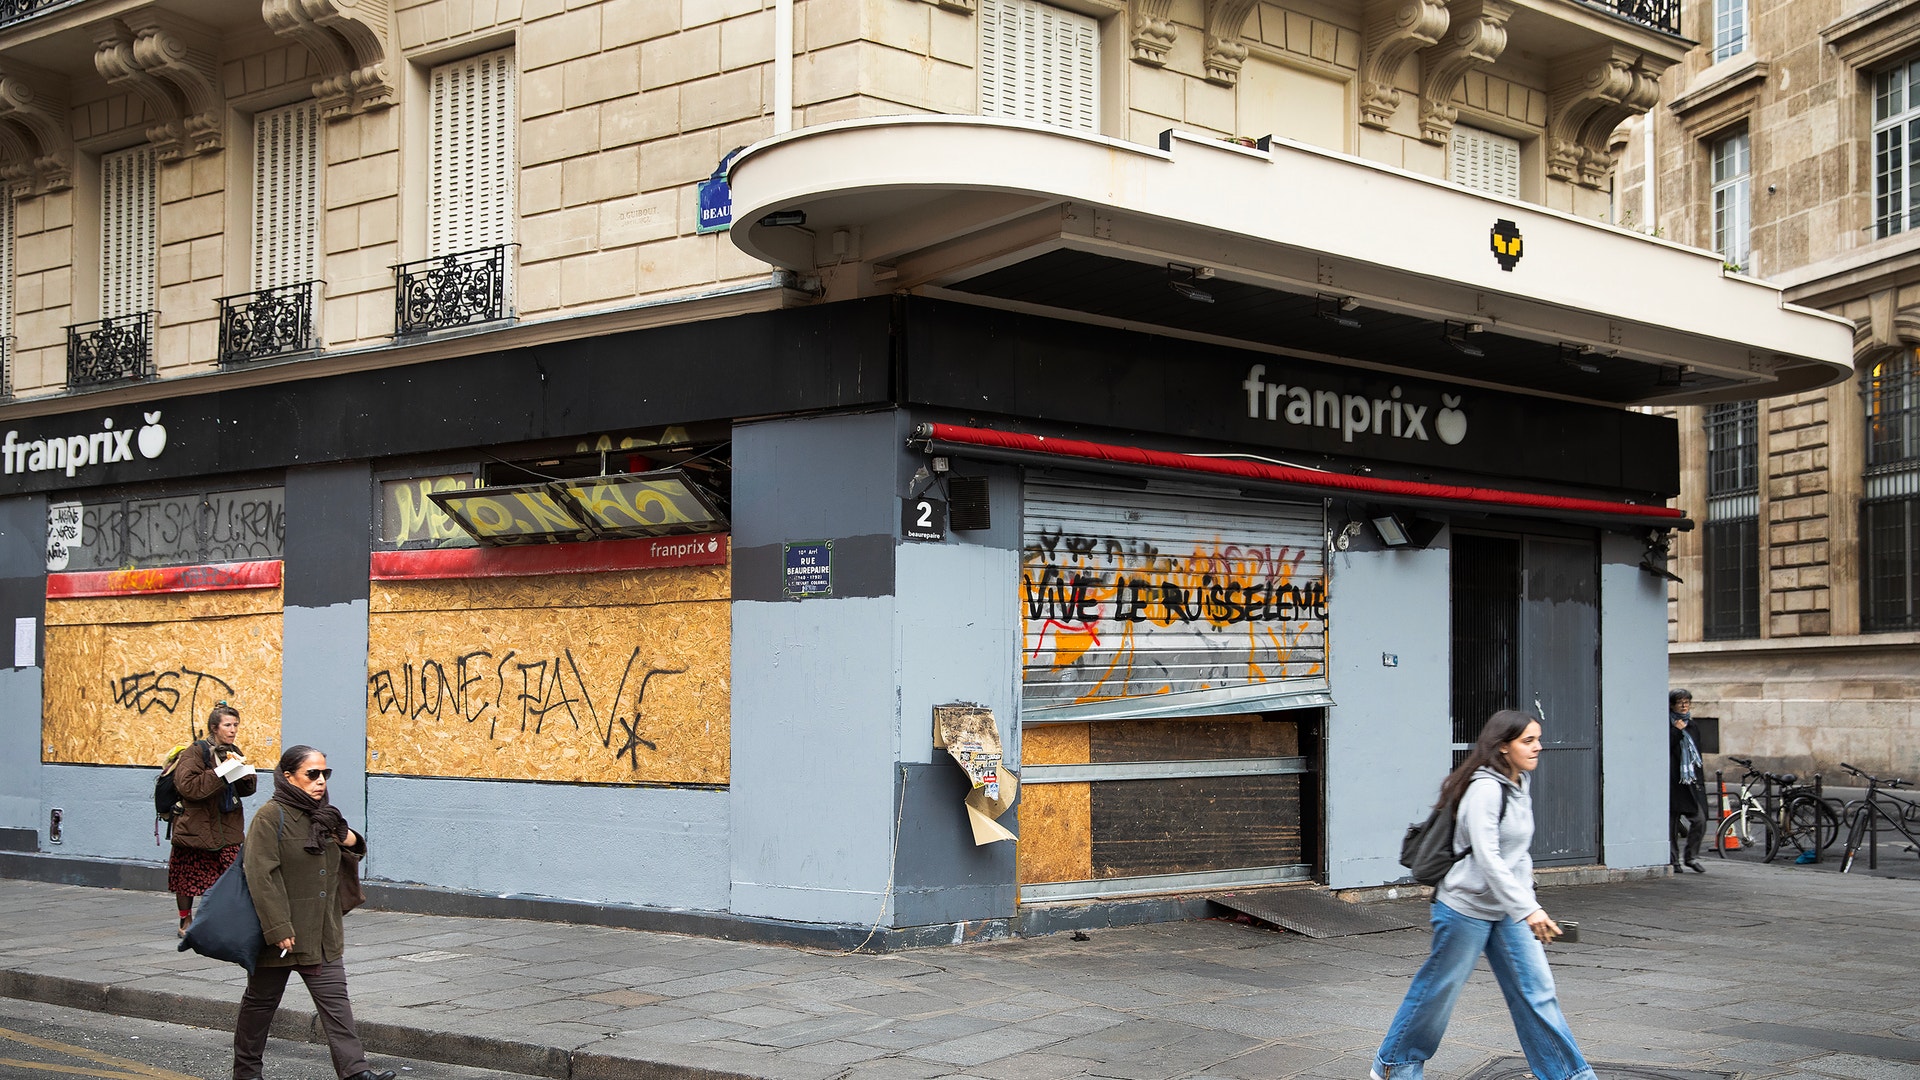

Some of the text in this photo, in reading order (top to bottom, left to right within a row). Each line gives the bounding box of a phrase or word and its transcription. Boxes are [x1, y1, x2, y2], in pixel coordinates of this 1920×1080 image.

[1242, 363, 1429, 443] franprix
[1, 417, 135, 477] franprix
[916, 501, 932, 528] 2
[908, 530, 941, 540] beaurepaire
[650, 539, 705, 559] franprix
[786, 565, 830, 576] BEAUREPAIRE
[800, 557, 816, 566] RUE
[1115, 575, 1153, 623] LE
